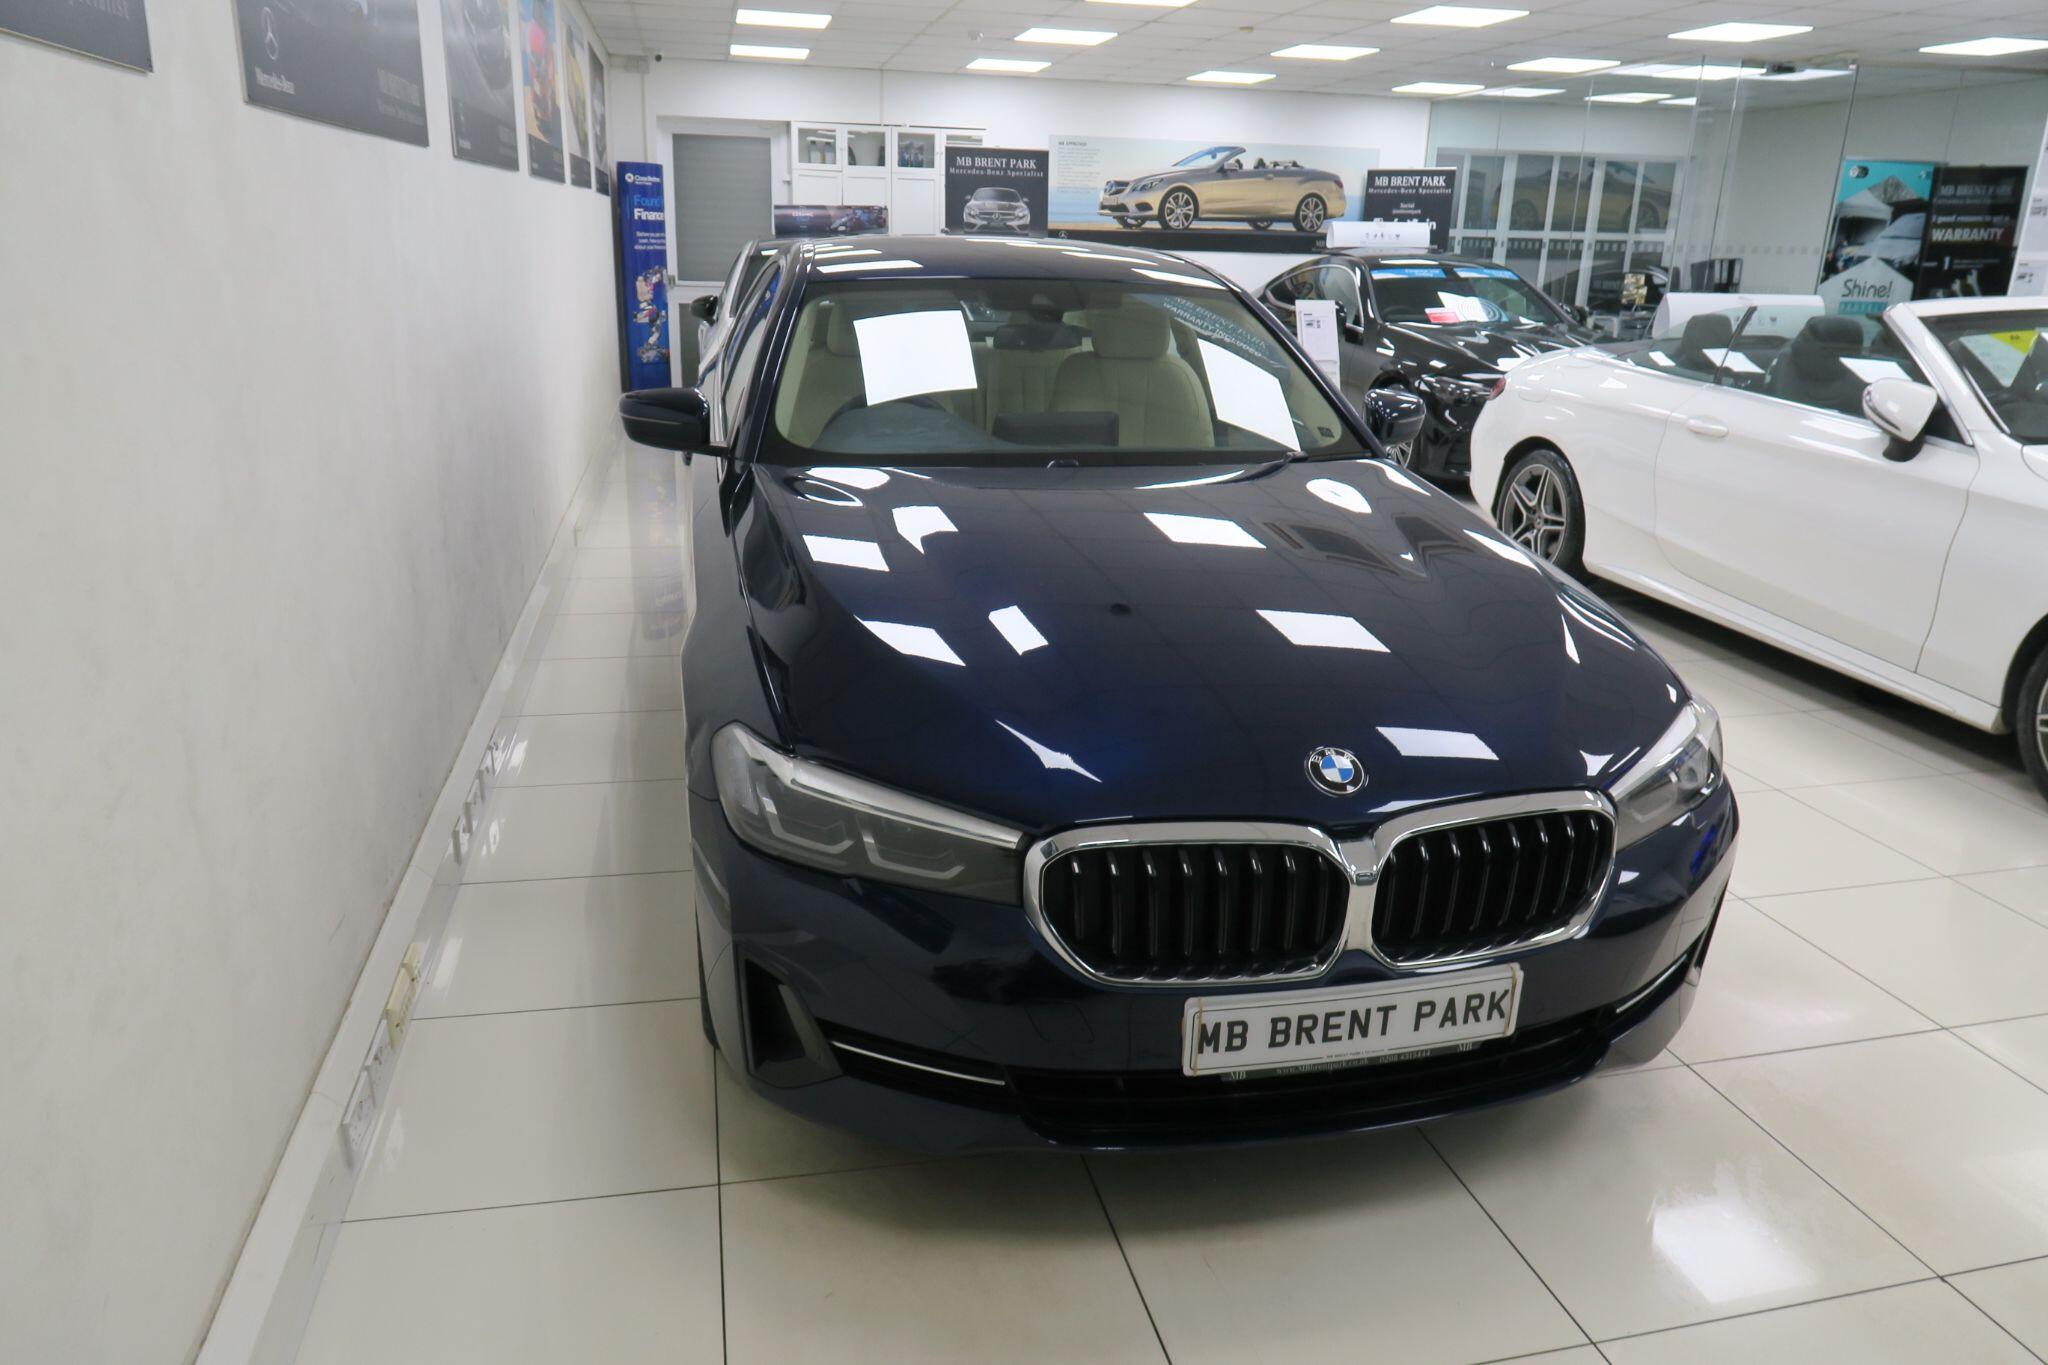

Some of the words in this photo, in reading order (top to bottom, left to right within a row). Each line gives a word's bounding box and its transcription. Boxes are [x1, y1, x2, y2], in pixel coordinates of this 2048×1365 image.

[956, 156, 972, 166] MB
[974, 157, 1007, 168] BRENT
[1010, 158, 1037, 169] PARK
[1374, 176, 1389, 186] MB
[1390, 175, 1421, 187] BRENT
[1421, 175, 1446, 187] PARK
[1931, 228, 2004, 242] WARRANTY
[1840, 276, 1893, 299] Shine!
[1163, 302, 1214, 329] WARRANTY
[1198, 1020, 1248, 1054] MB
[1268, 1005, 1397, 1048] BRENT
[1413, 989, 1509, 1032] PARK
